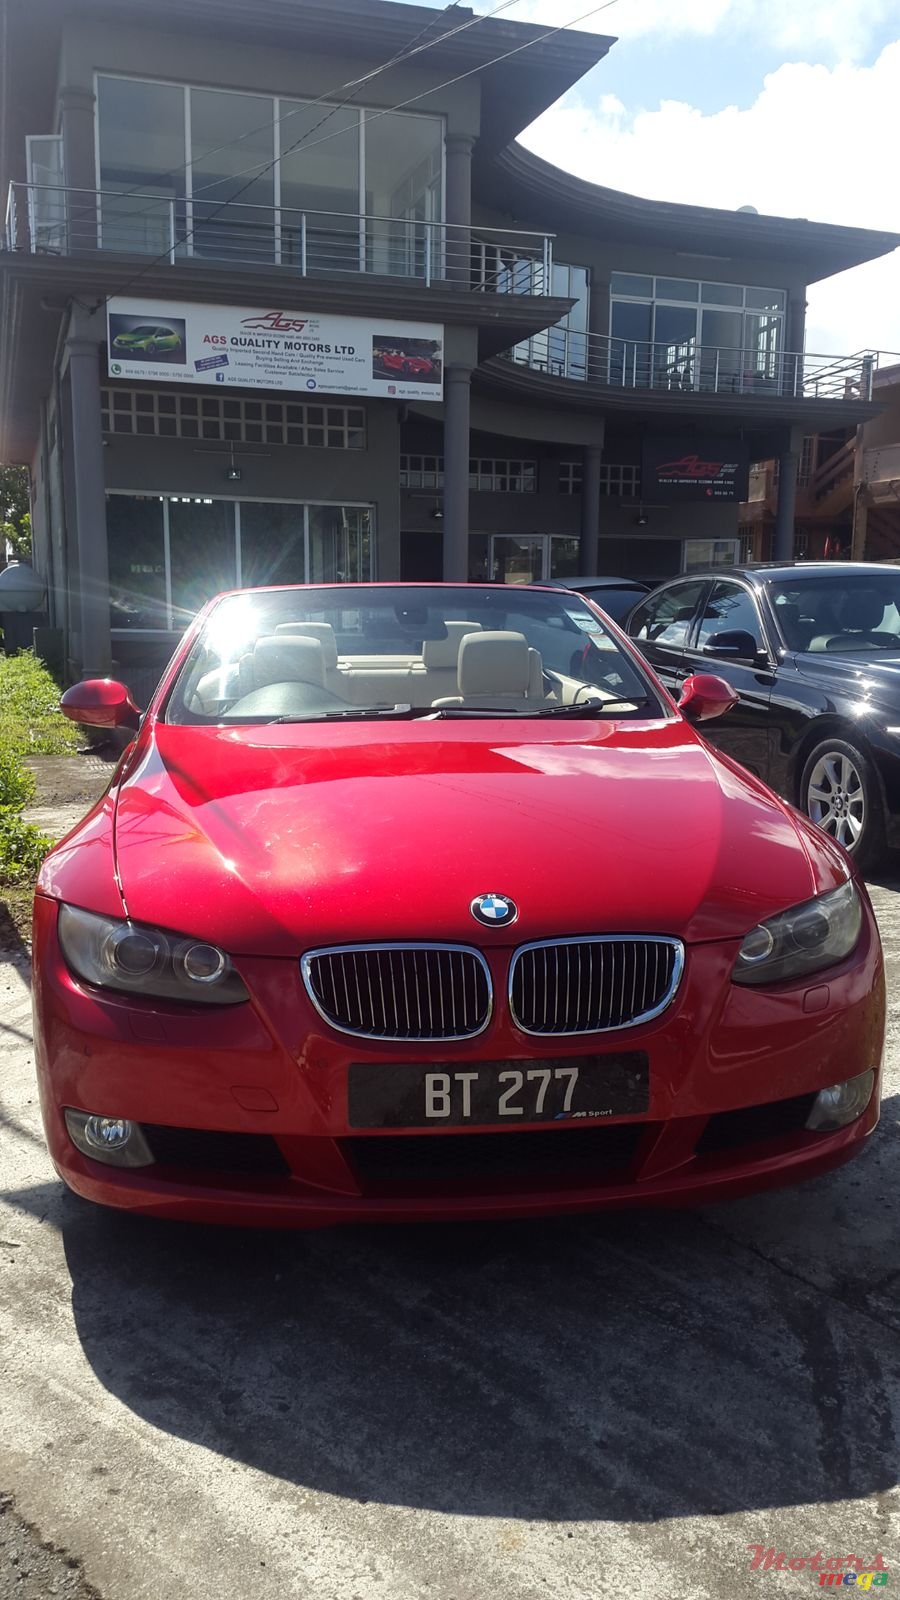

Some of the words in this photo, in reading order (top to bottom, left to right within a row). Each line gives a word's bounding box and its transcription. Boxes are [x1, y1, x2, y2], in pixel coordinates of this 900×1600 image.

[203, 335, 227, 345] AGS
[230, 336, 281, 351] QUALITY
[284, 341, 332, 354] MOTORS
[334, 345, 356, 356] LTD
[255, 355, 273, 363] Buying
[273, 356, 290, 364] Selling
[299, 352, 316, 360] Quality
[425, 1072, 479, 1118] BT
[498, 1067, 579, 1116] 277
[588, 1109, 613, 1118] Sport
